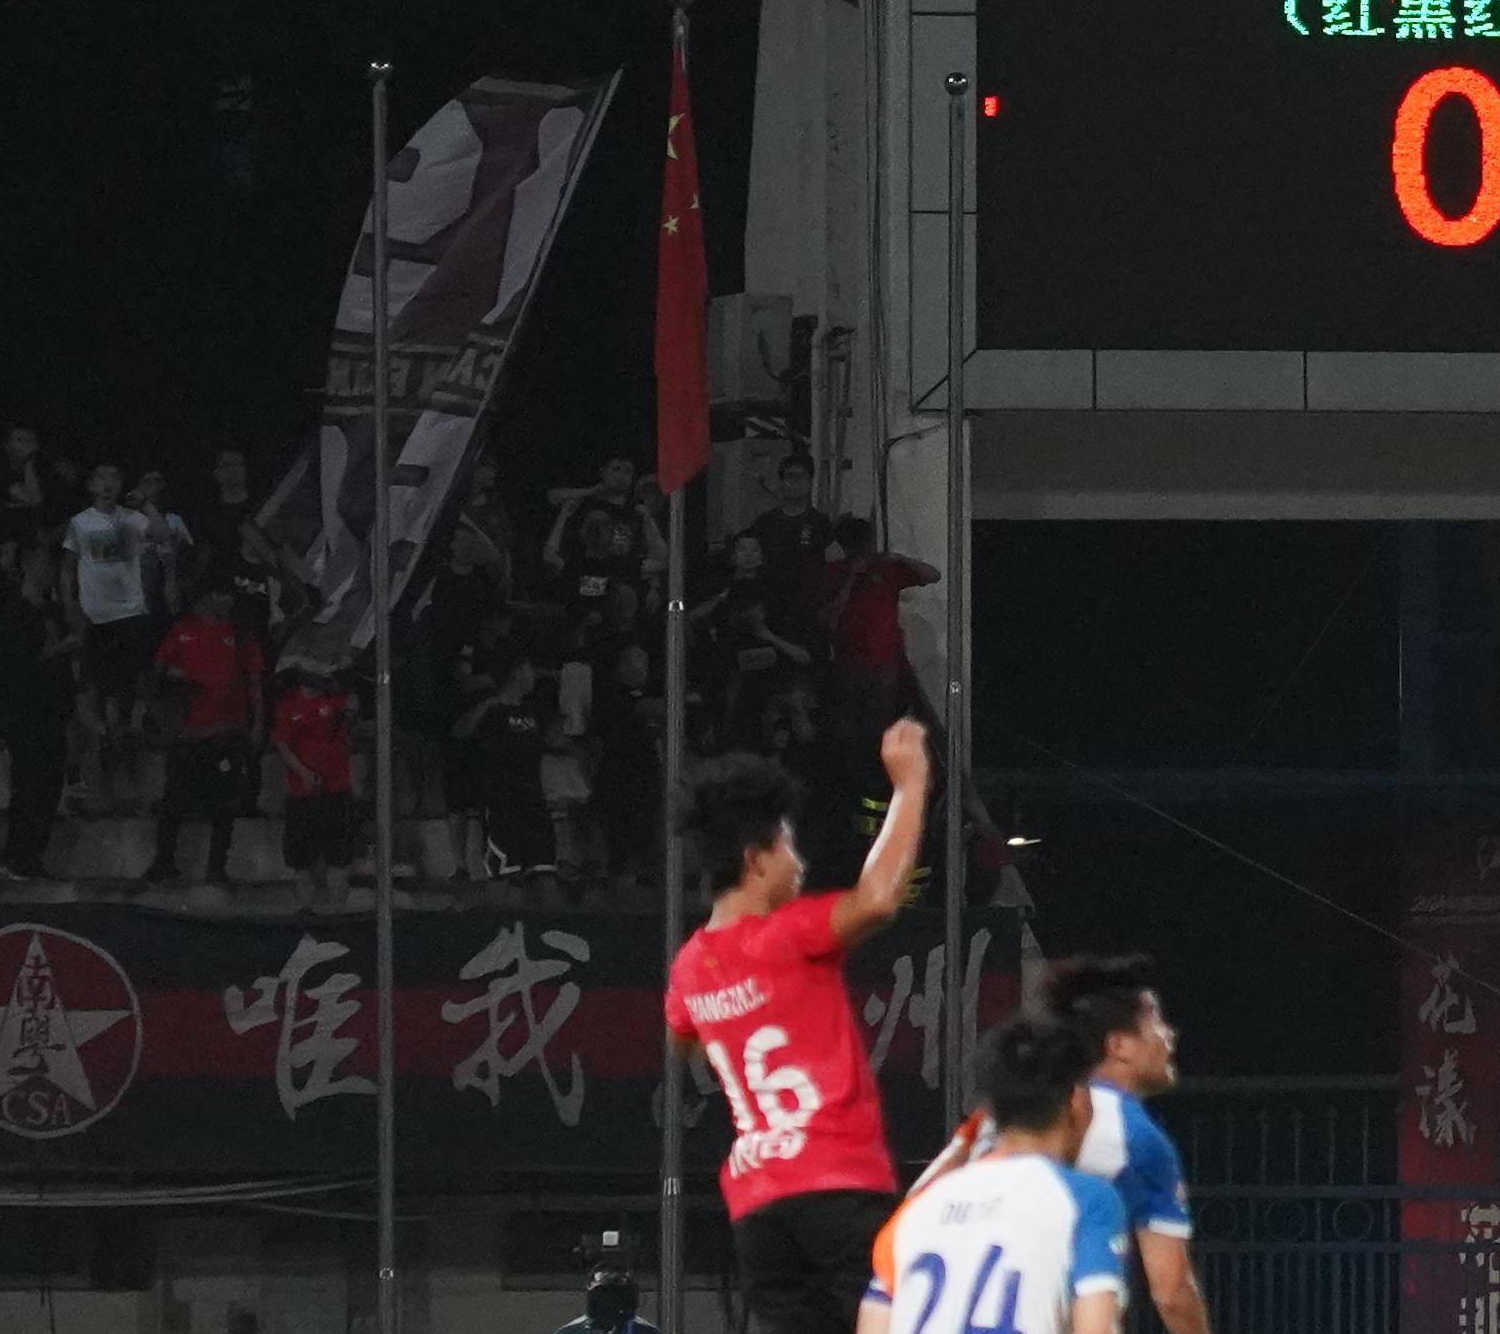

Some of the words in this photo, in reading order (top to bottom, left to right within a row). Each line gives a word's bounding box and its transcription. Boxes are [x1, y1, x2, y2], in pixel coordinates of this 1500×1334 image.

[224, 919, 992, 1127] 唯我州
[705, 1026, 821, 1131] 16
